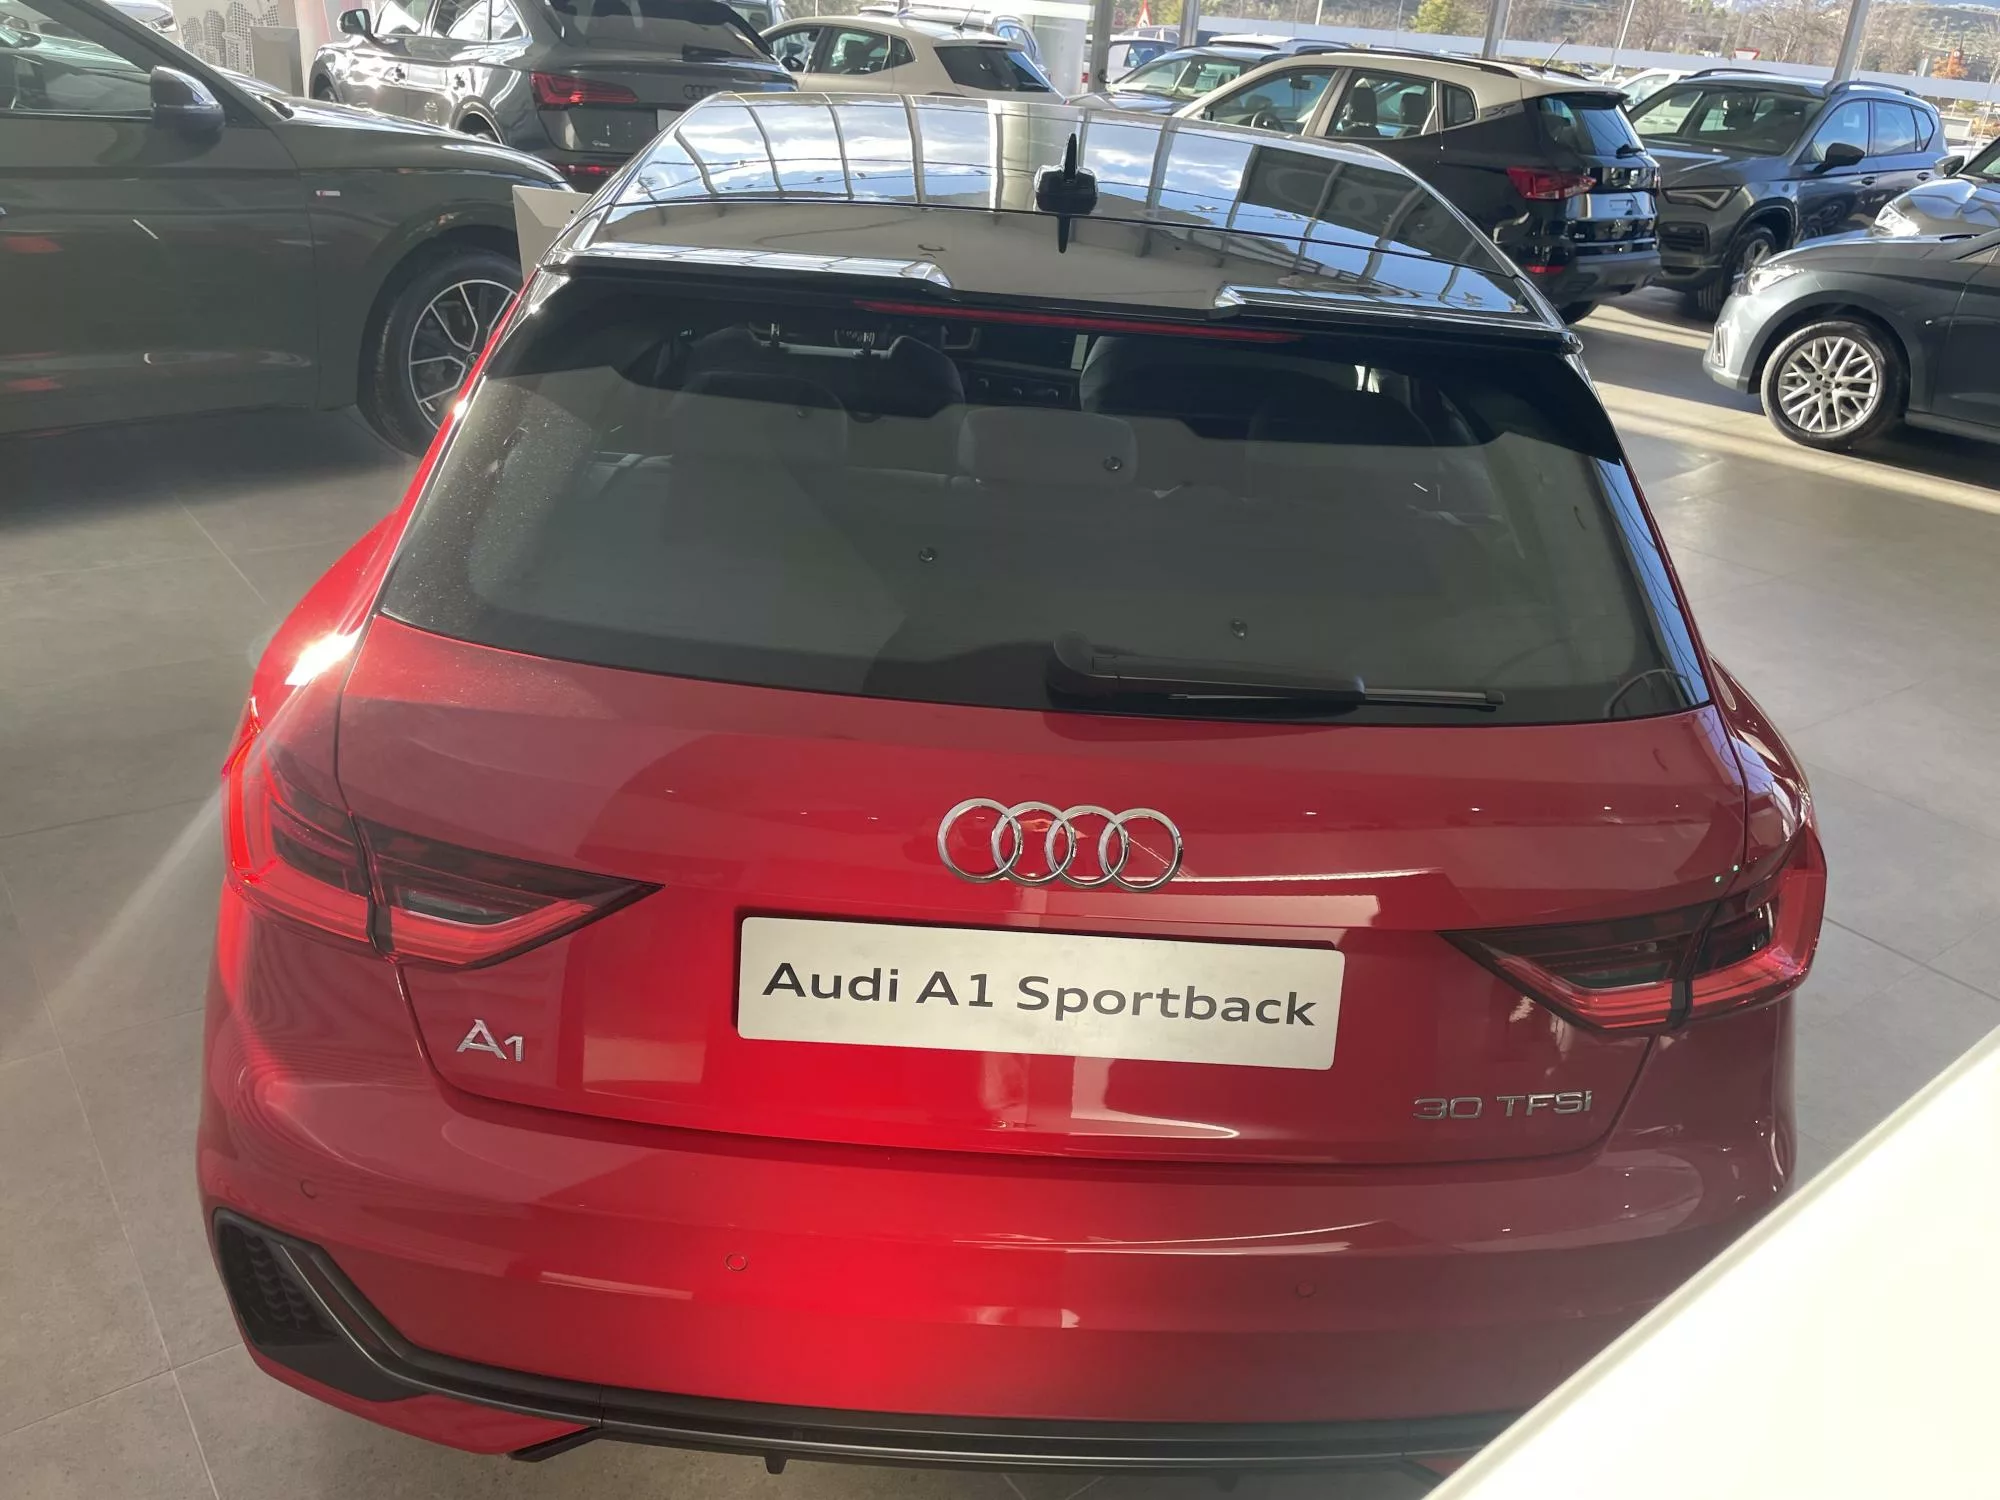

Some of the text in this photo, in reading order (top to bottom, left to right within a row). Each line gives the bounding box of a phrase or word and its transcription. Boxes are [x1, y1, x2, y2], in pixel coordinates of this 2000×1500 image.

[762, 962, 1317, 1027] Audi A1 Sportback
[456, 1018, 524, 1062] A1
[1413, 1096, 1483, 1120] 30
